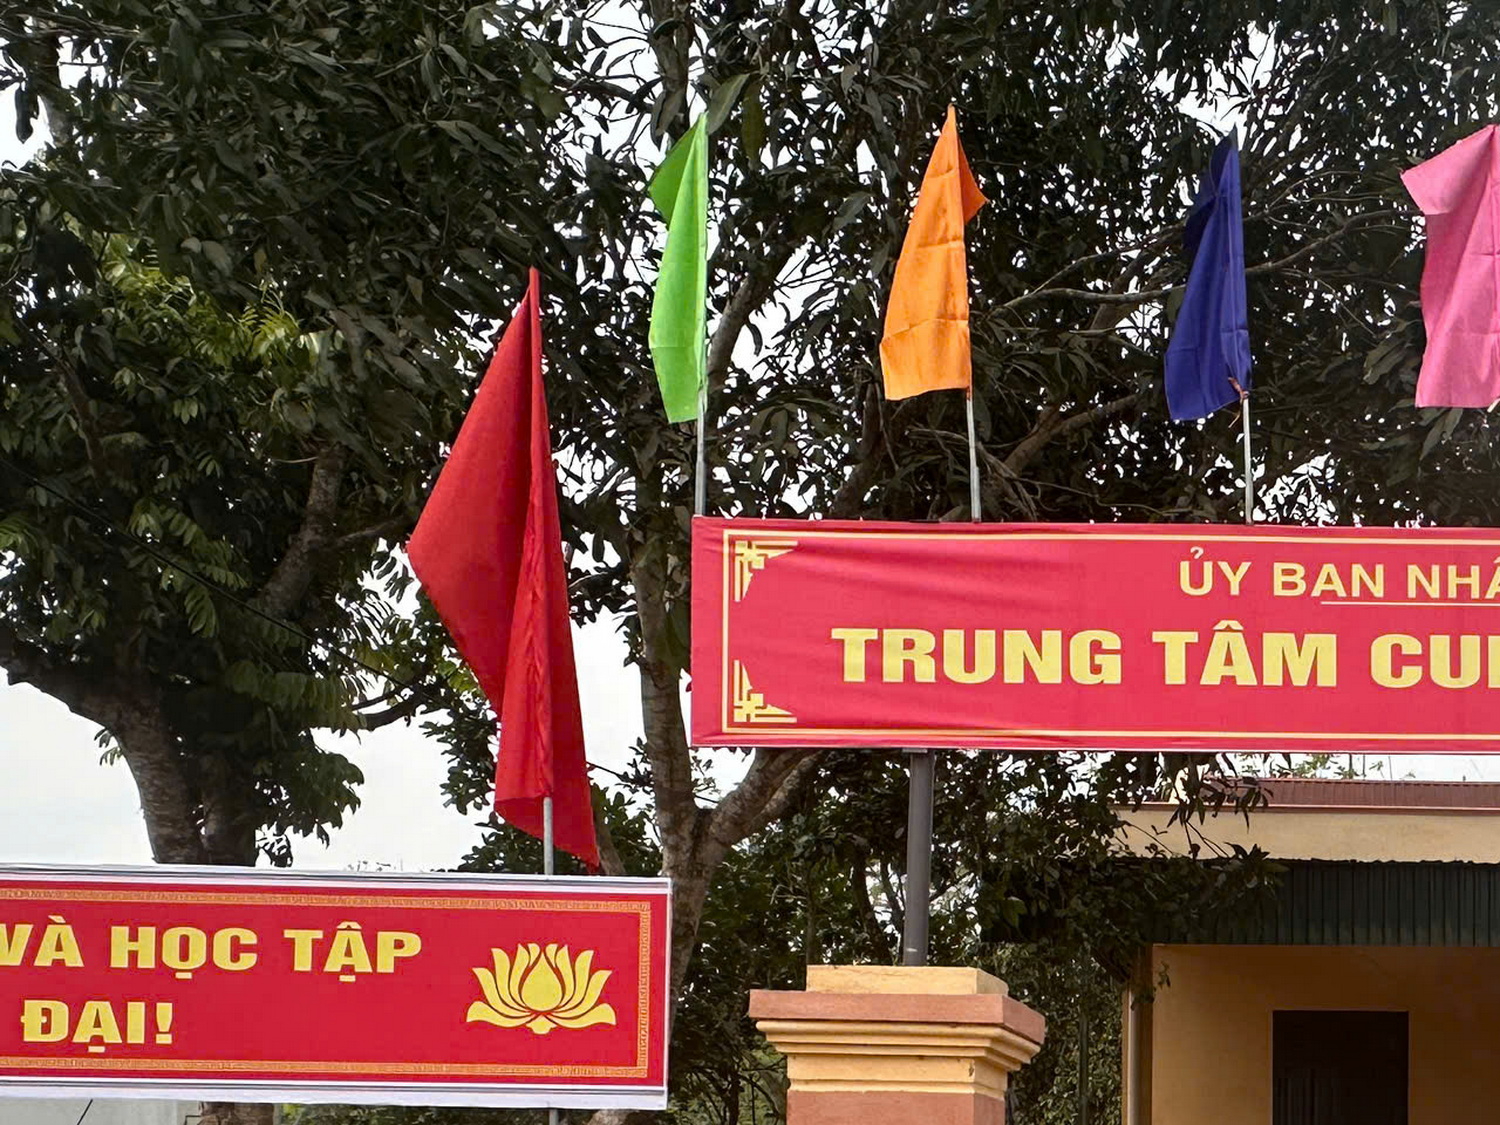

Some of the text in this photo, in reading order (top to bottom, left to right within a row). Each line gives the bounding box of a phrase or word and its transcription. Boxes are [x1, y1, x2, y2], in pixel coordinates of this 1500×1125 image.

[1179, 546, 1252, 596] ỦY
[1273, 562, 1385, 598] BAN
[830, 627, 1122, 685] TRUNG
[1151, 619, 1337, 687] TÂM
[0, 915, 423, 983] VÀ HỌC TẬP
[20, 999, 173, 1053] ĐẠI!
